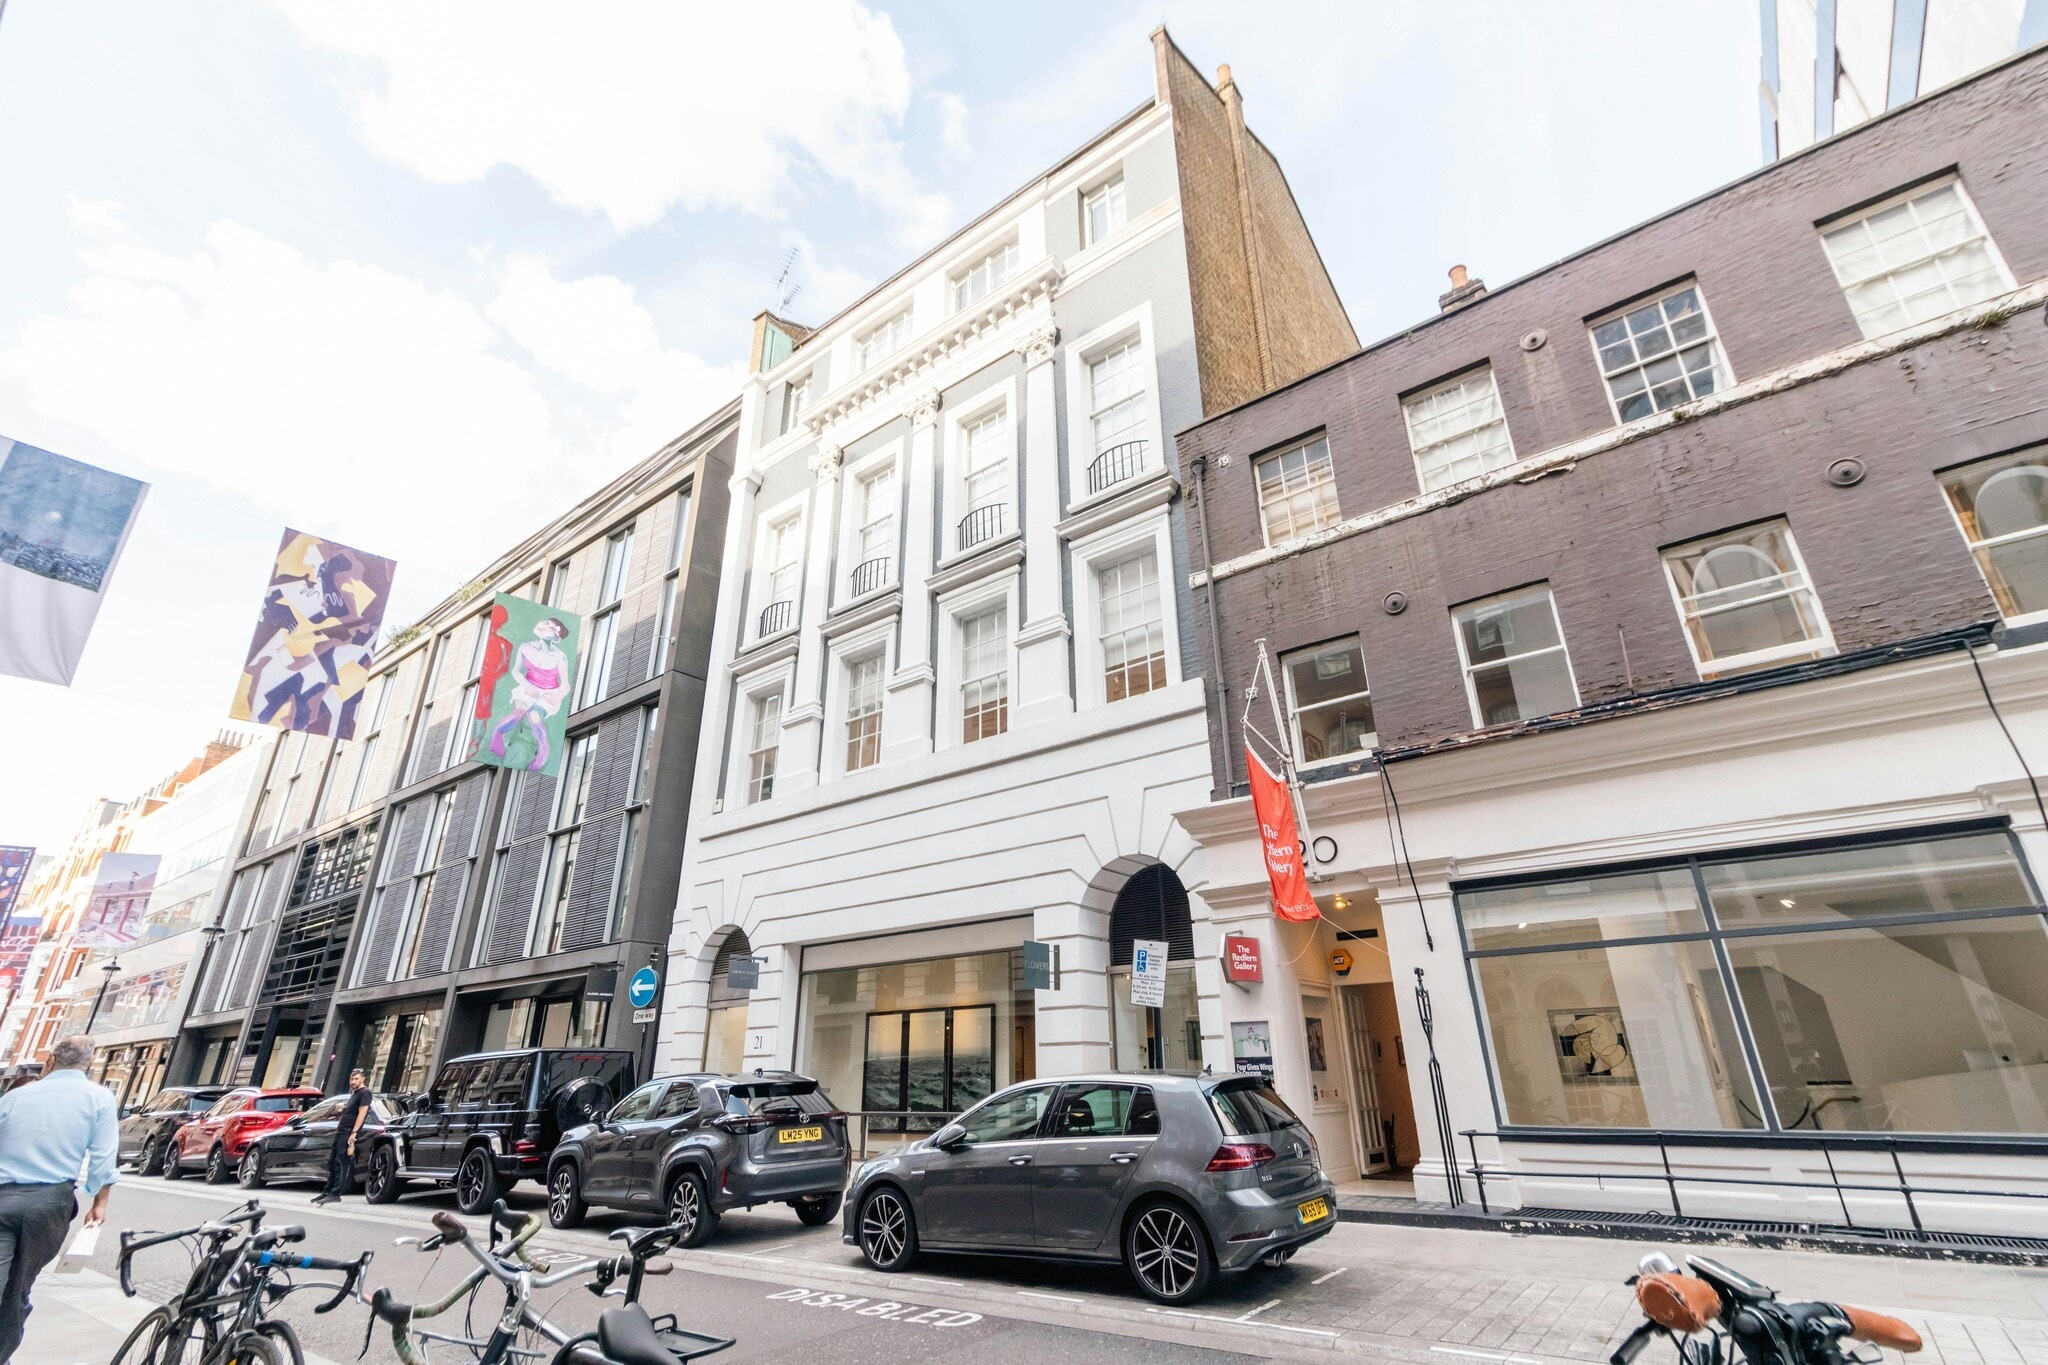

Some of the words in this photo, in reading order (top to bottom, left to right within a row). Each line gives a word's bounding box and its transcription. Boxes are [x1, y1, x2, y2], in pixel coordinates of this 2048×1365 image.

[1262, 824, 1278, 840] The
[1236, 944, 1250, 954] The
[1232, 953, 1257, 962] Redfern
[1024, 960, 1049, 970] FLOWERS
[1234, 961, 1257, 973] Gallery
[754, 1036, 762, 1049] 21
[782, 1130, 802, 1140] LM25
[804, 1128, 819, 1138] YNG
[766, 1288, 984, 1327] DISABLED
